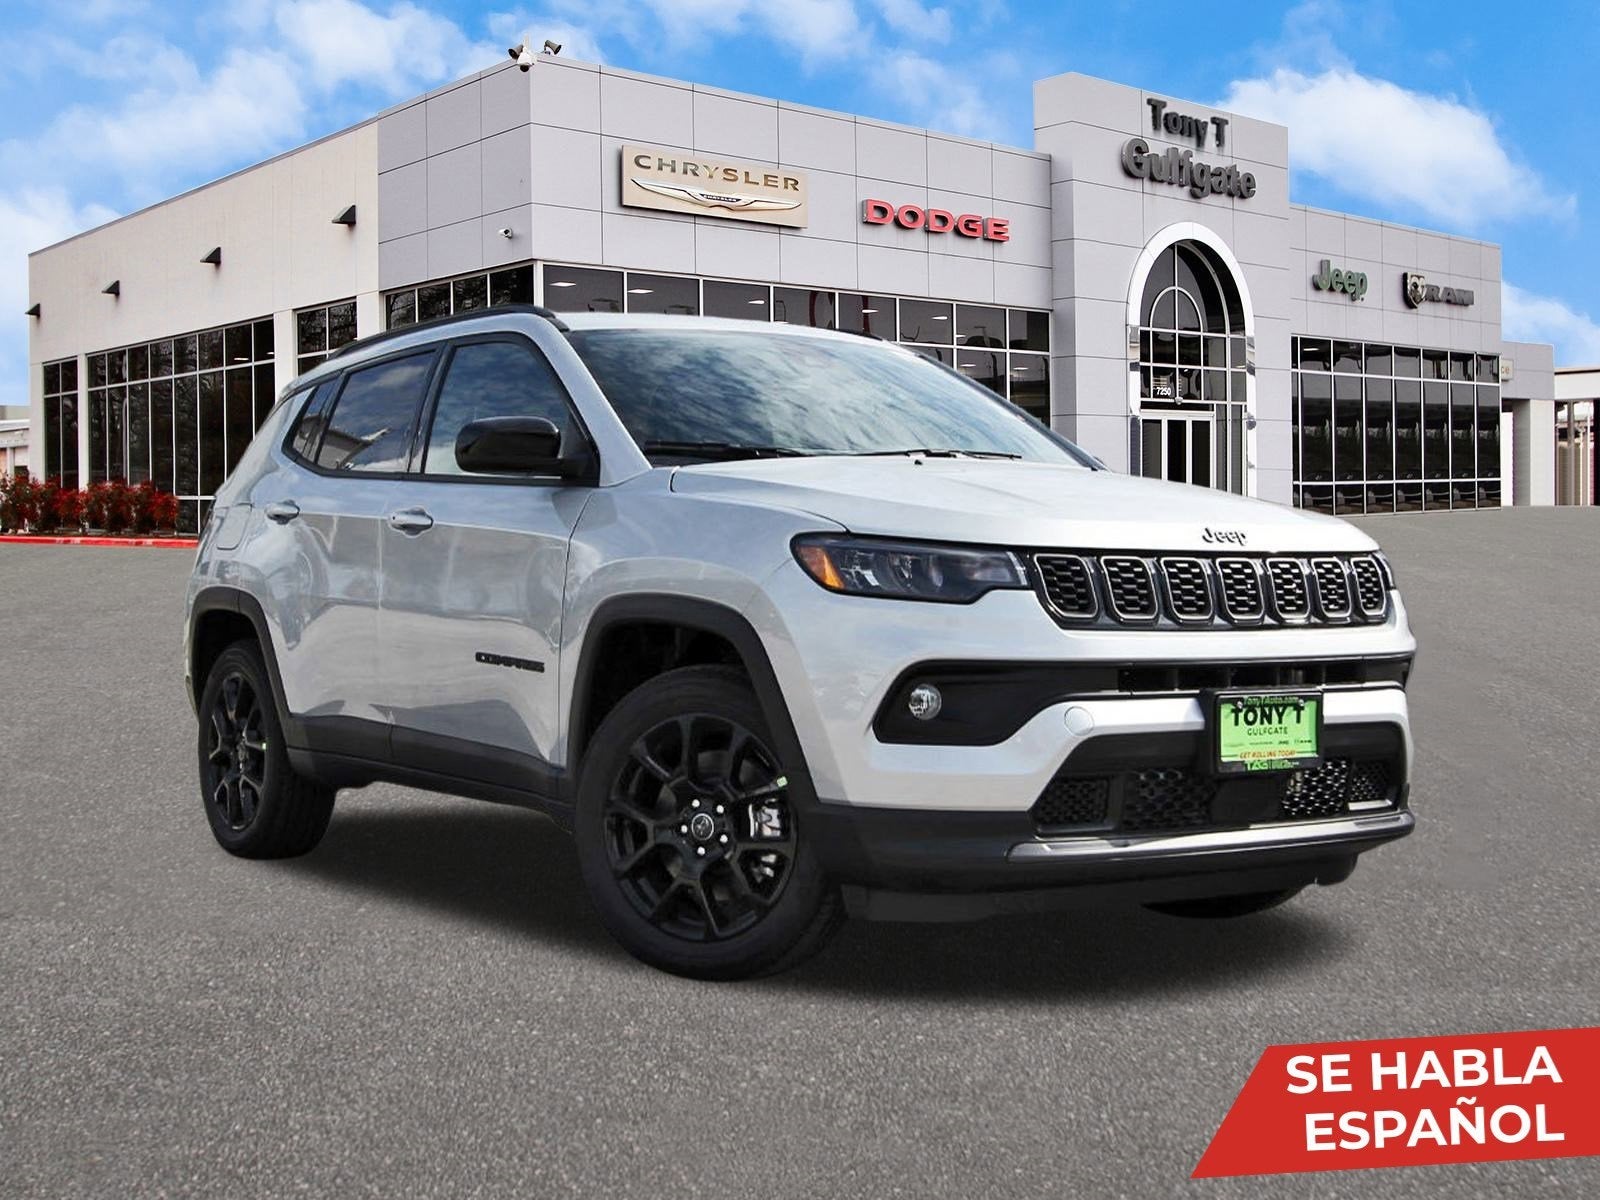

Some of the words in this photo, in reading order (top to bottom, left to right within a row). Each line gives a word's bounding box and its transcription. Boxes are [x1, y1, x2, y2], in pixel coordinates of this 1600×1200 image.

[1146, 98, 1208, 148] Tony
[1210, 115, 1229, 148] T
[634, 154, 800, 192] CHRYSLER
[1120, 138, 1256, 199] Gulfgate
[862, 199, 1010, 243] DODGE
[1312, 259, 1368, 302] Jeep
[1425, 284, 1475, 306] RAM
[1156, 386, 1172, 396] 7250
[1202, 527, 1247, 547] Jeep
[1231, 703, 1289, 726] TONY
[1293, 702, 1305, 724] T
[1247, 726, 1289, 736] GULFGATE
